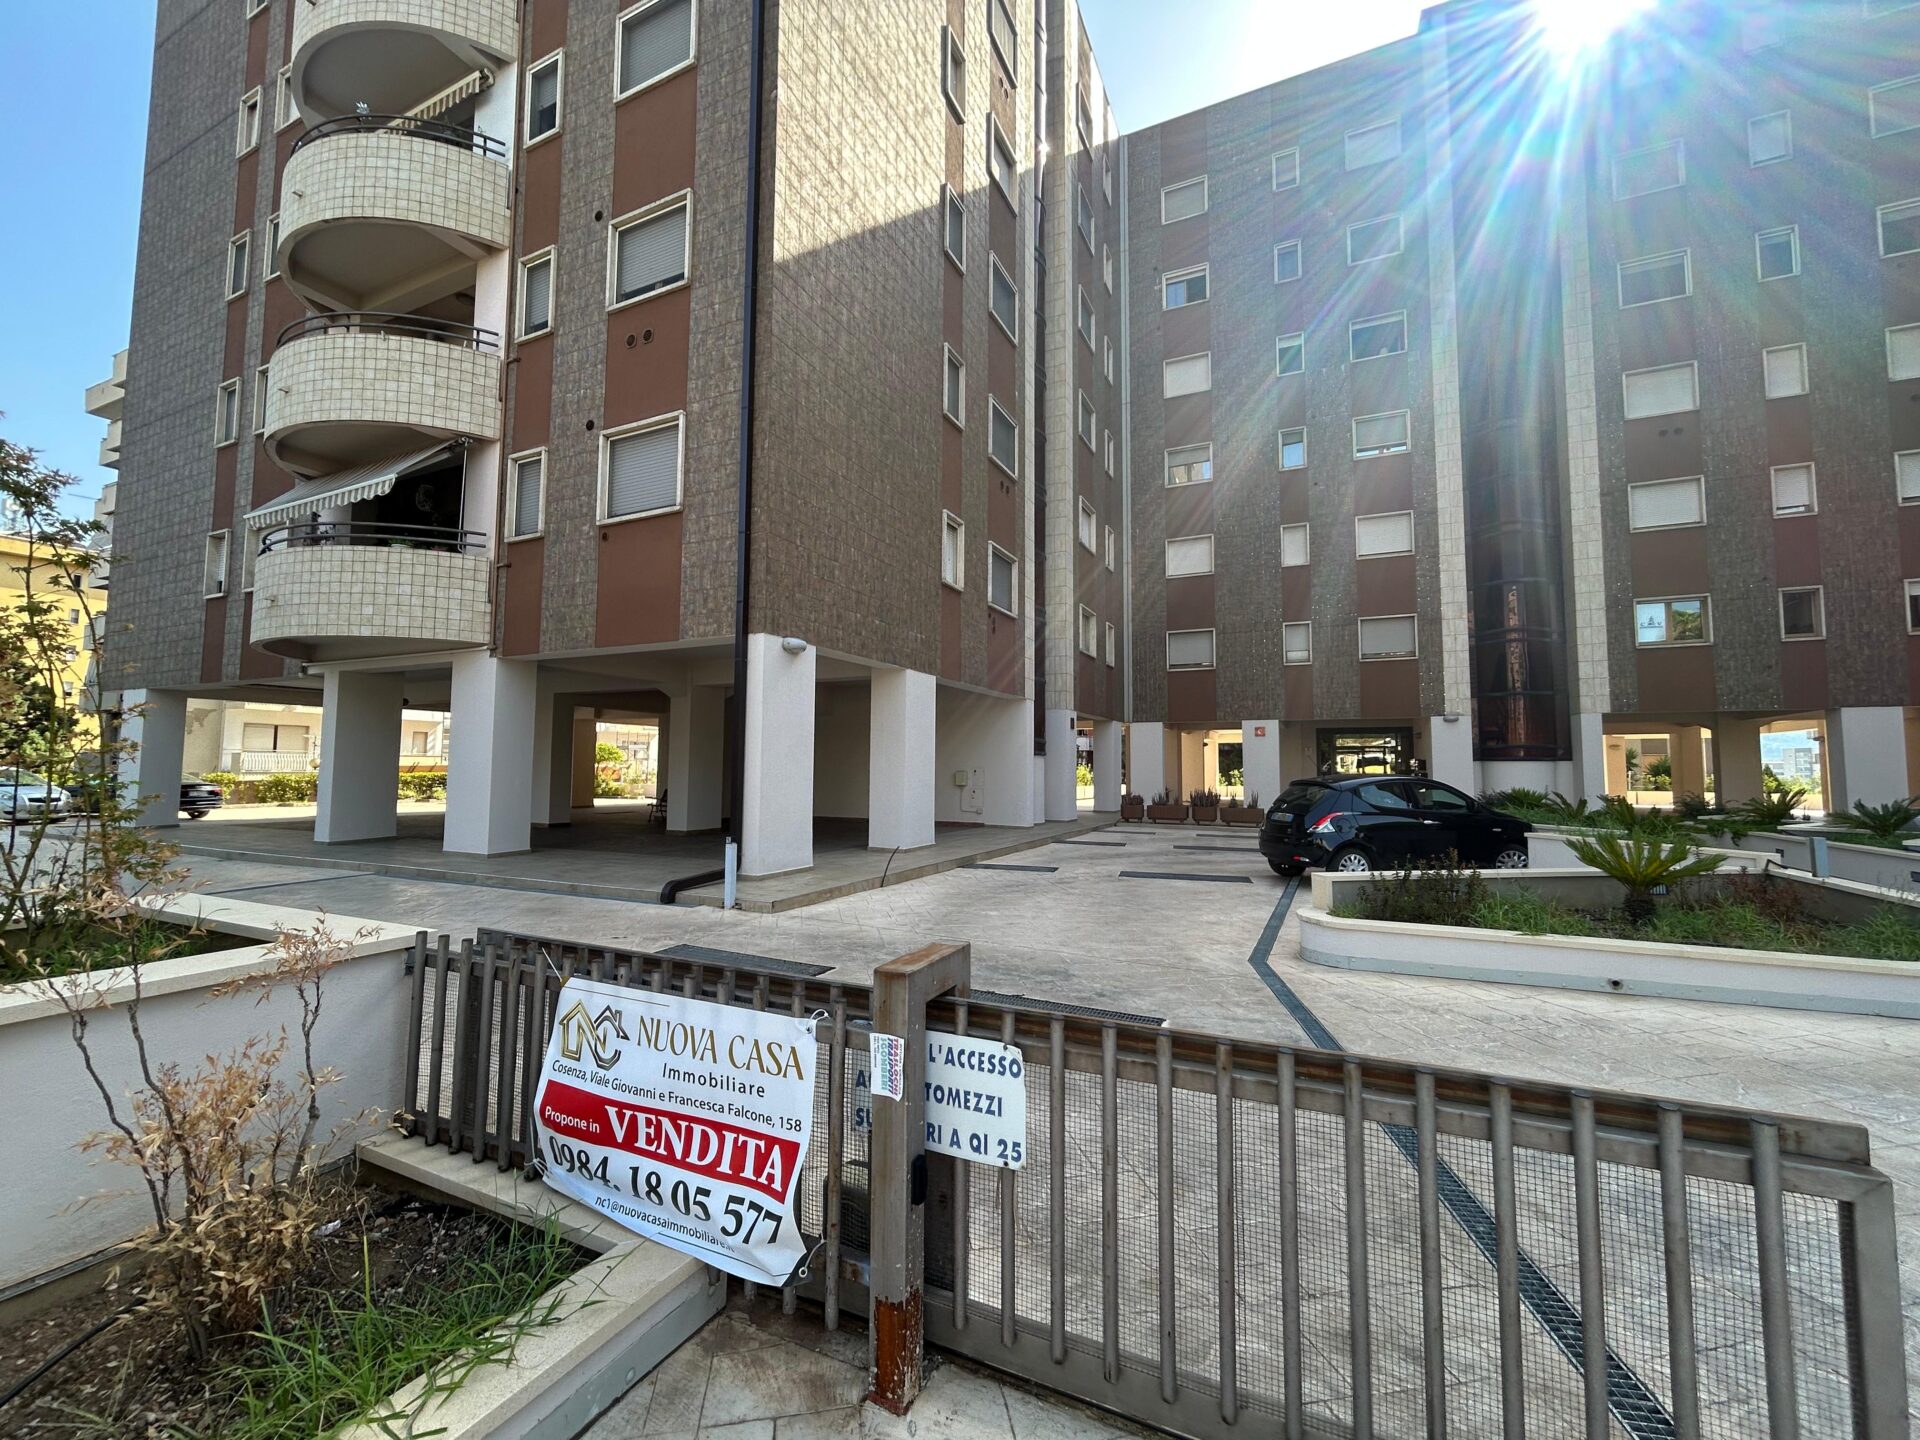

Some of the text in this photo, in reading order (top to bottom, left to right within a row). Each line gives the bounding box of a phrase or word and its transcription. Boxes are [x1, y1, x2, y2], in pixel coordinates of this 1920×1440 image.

[637, 1015, 804, 1080] NUOVA CASA
[928, 1043, 1022, 1079] L'ACCESSO
[552, 1059, 802, 1132] Cosenza, Viale Giovanni e Francesca Falcone, 158
[662, 1062, 765, 1098] Immobiliare
[925, 1082, 1003, 1118] TOMEZZI
[545, 1105, 783, 1193] Propone in VENDITA
[949, 1128, 961, 1149] A
[969, 1132, 988, 1156] QI
[997, 1138, 1022, 1164] 25
[549, 1135, 783, 1245] 0984. 18 05 577
